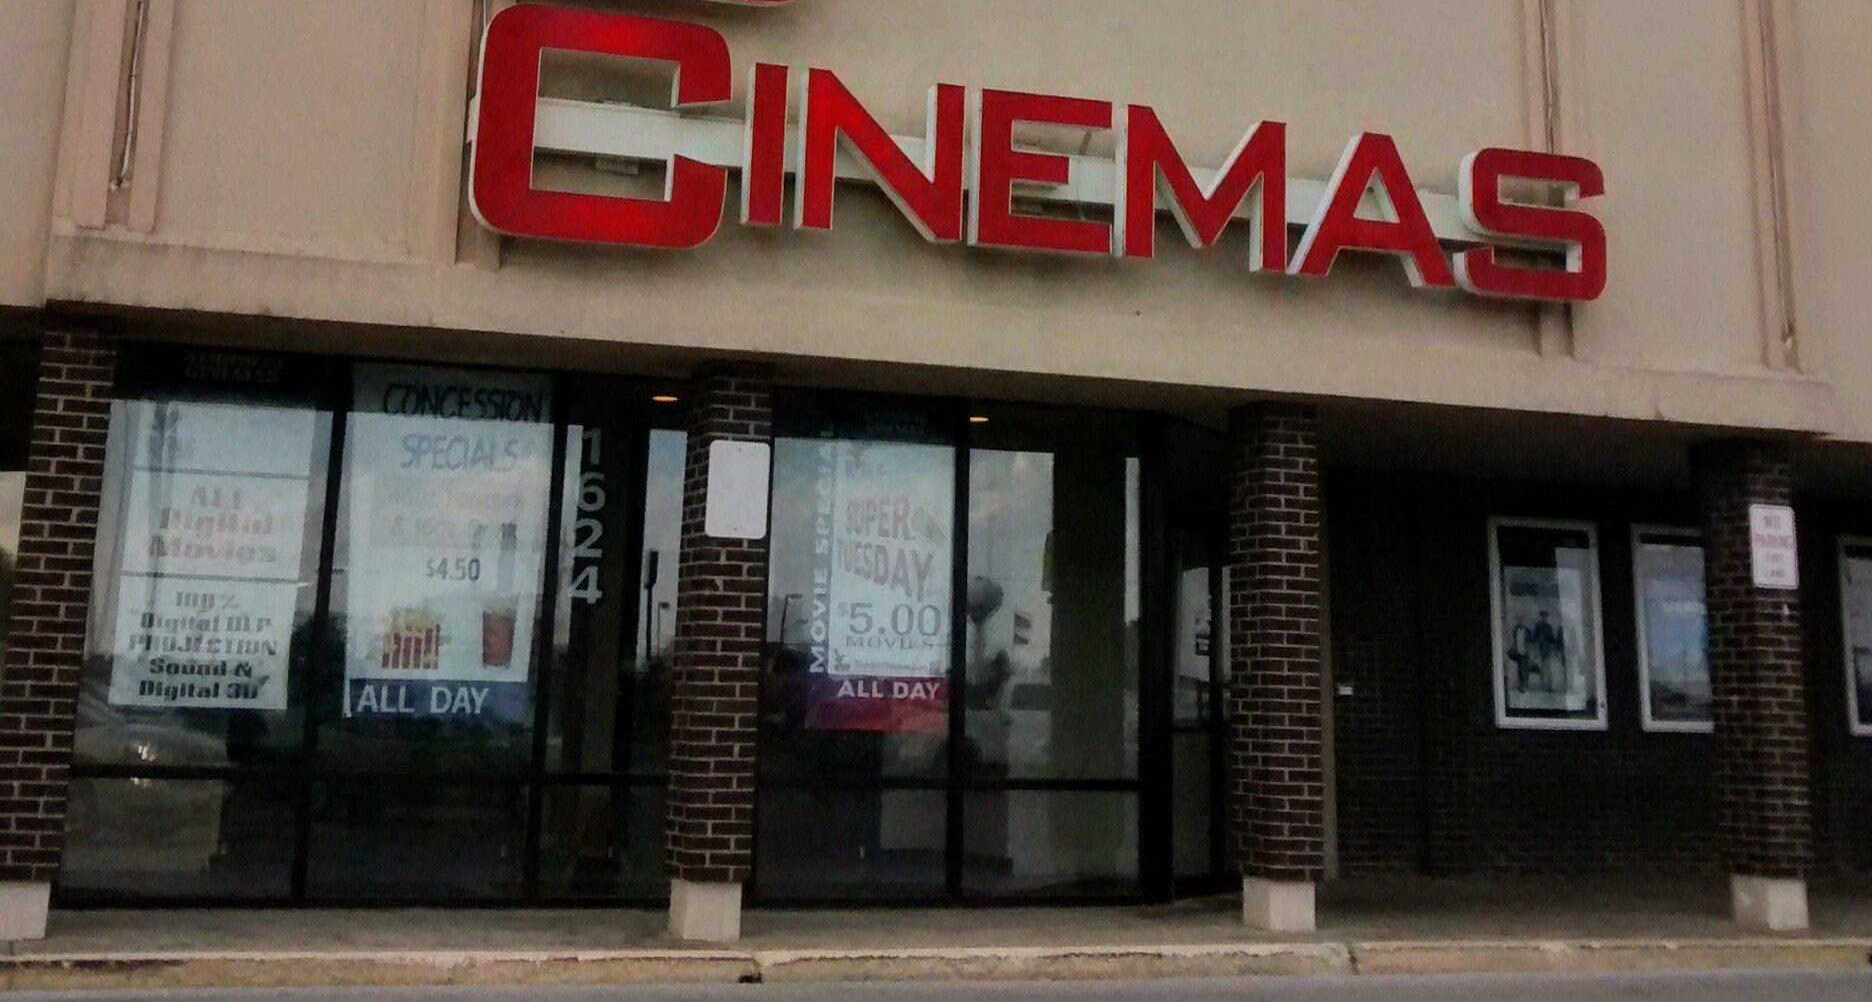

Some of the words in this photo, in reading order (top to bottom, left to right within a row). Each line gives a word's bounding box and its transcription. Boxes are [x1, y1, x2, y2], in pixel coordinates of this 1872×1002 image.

[468, 1, 1607, 301] CINEMAS
[382, 381, 545, 423] CONCESSION
[401, 433, 519, 472] SPECIALS
[426, 557, 482, 582] $4.50
[837, 537, 934, 601] TUESDAY
[809, 567, 830, 674] MOVIE
[837, 601, 942, 637] $5.00
[149, 657, 227, 678] Sound
[139, 679, 220, 702] Digital
[357, 684, 415, 714] ALL
[430, 685, 490, 715] DAY
[837, 680, 884, 699] ALL
[892, 680, 942, 701] DAY
